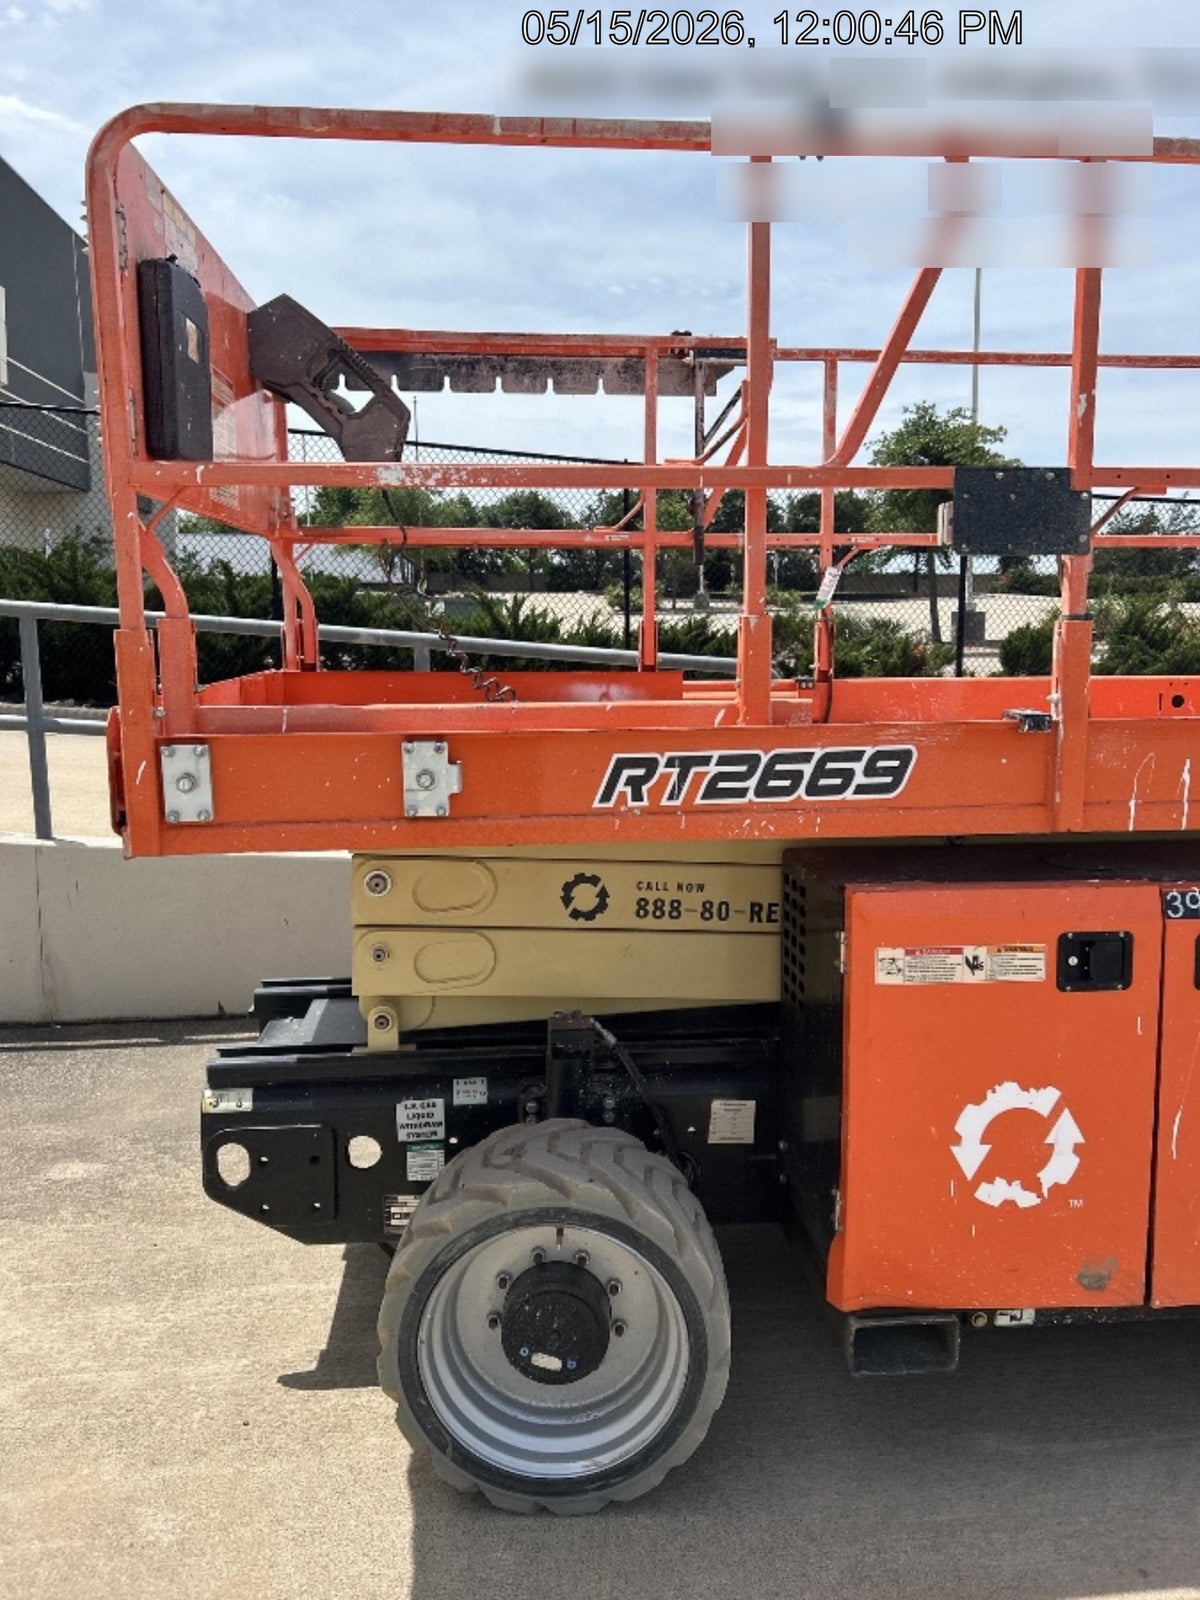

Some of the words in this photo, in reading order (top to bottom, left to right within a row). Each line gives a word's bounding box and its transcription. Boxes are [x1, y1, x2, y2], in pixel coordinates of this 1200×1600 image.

[593, 745, 917, 807] RT2669
[636, 881, 669, 892] CALL
[677, 882, 705, 893] NOW
[1068, 1199, 1083, 1208] TM
